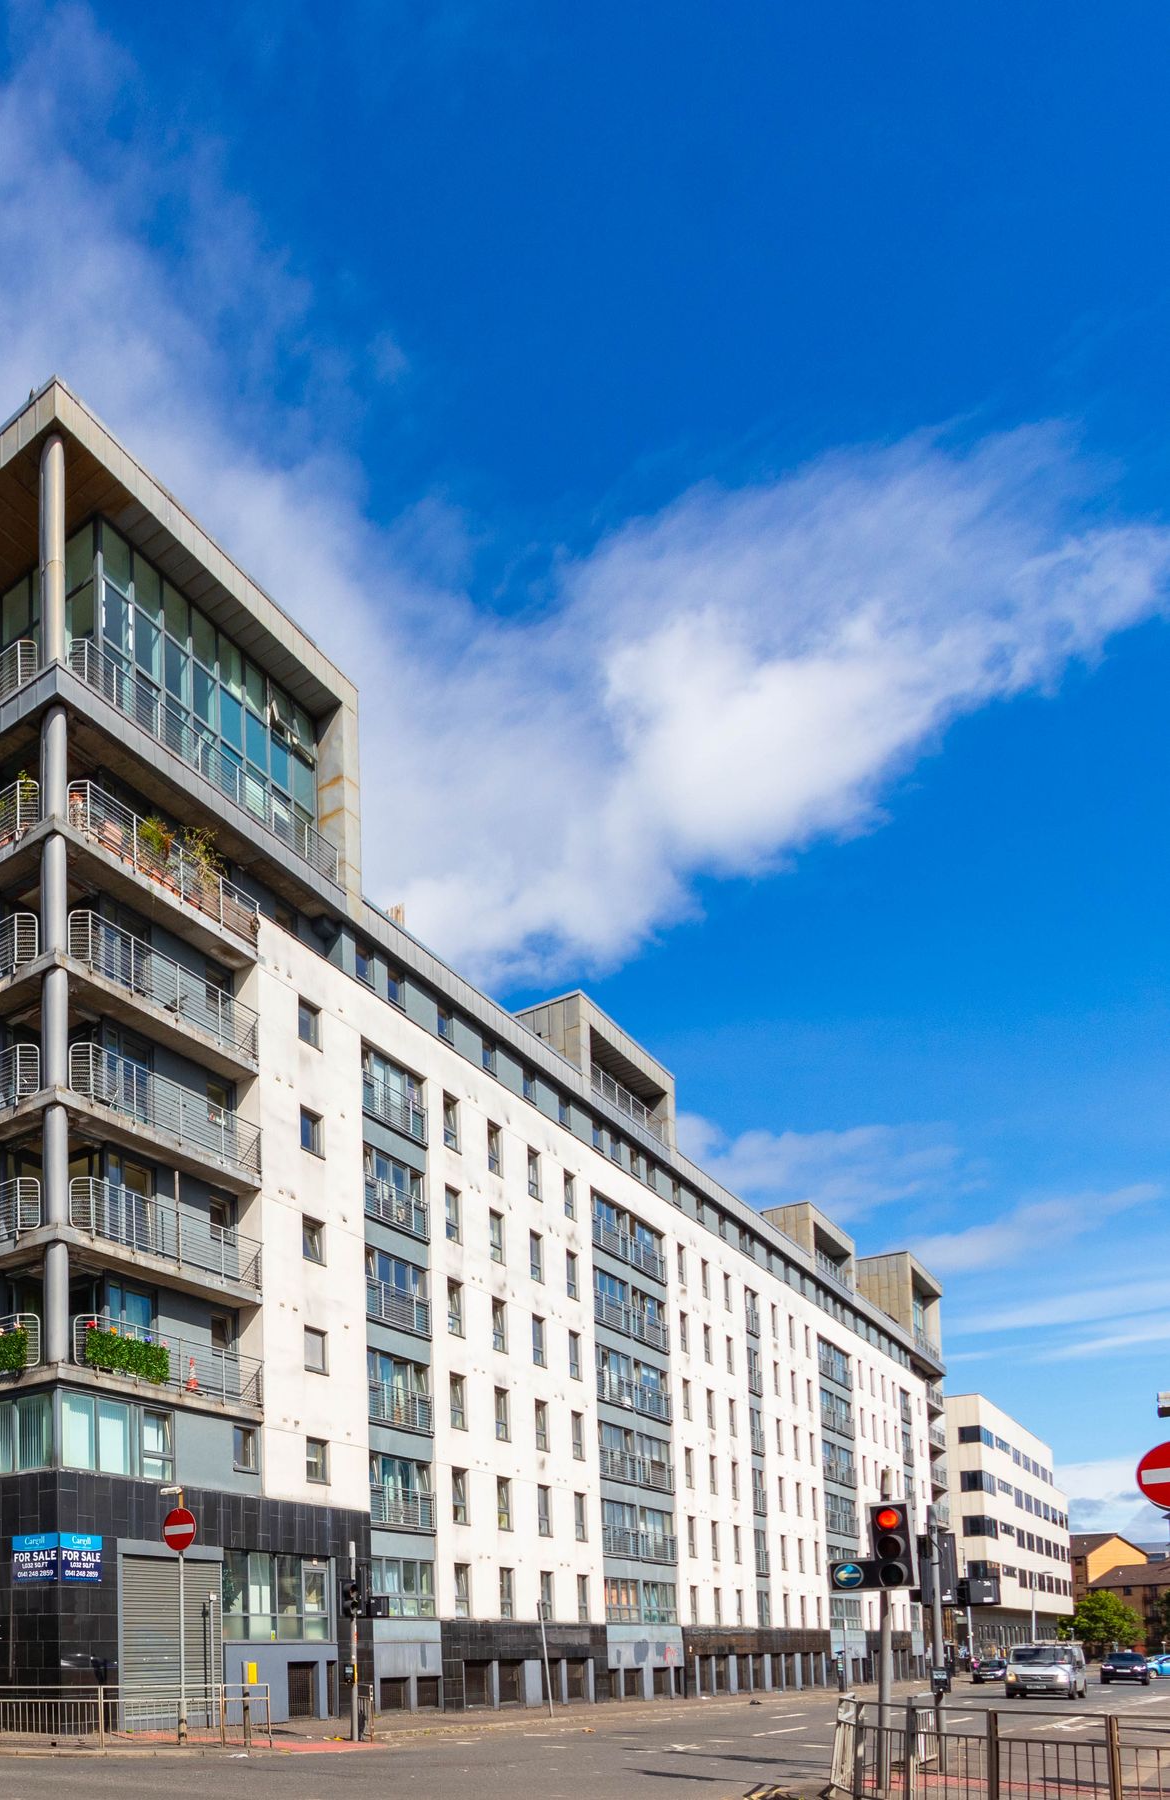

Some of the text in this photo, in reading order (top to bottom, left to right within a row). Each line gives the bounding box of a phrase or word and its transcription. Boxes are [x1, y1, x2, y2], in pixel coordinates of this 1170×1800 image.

[25, 1536, 45, 1546] Cargill
[72, 1536, 91, 1546] Cargill
[13, 1550, 57, 1563] FOR SALE
[62, 1550, 101, 1563] FOR SALE
[39, 1569, 54, 1577] 2859
[64, 1569, 76, 1577] 0141
